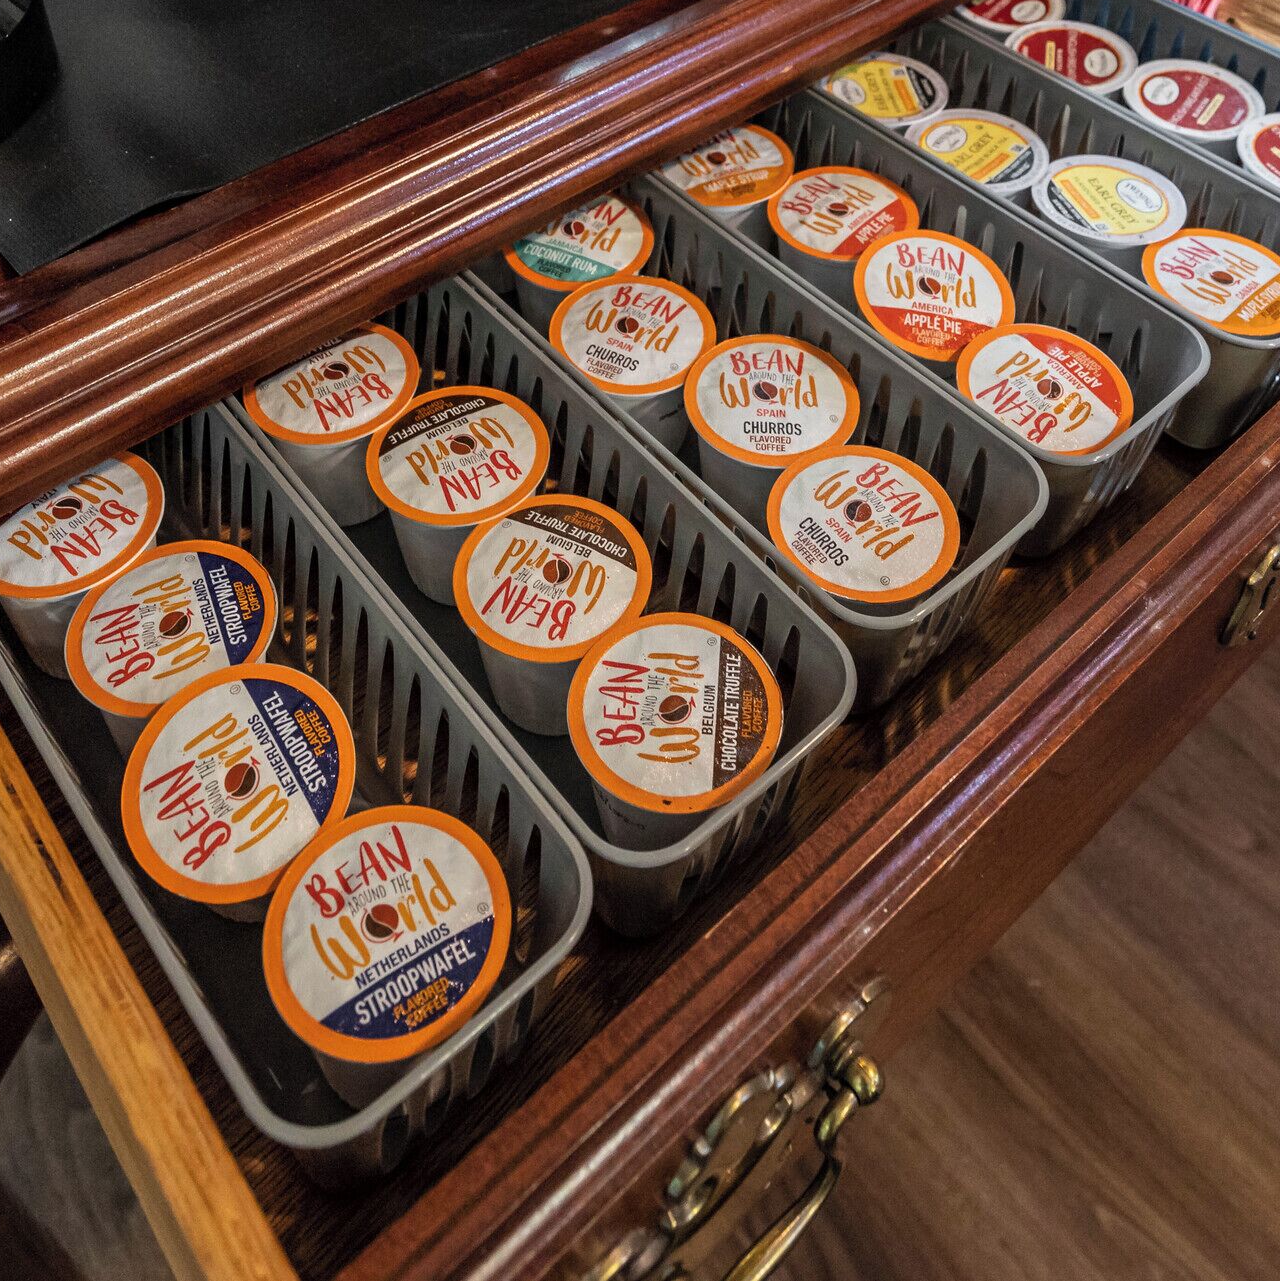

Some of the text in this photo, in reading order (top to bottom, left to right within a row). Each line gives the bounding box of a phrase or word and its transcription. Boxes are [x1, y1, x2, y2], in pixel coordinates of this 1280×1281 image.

[1085, 175, 1115, 204] EARL
[1109, 199, 1140, 228] GREY
[854, 219, 883, 244] APPLE
[875, 210, 894, 227] PIE
[523, 243, 598, 275] COCONUT RUM
[896, 243, 965, 277] BEAN
[1160, 237, 1220, 280] BEAN
[611, 285, 687, 324] BEAN
[904, 313, 962, 335] APPLE PIE
[911, 301, 954, 315] AMERICA
[1237, 294, 1268, 323] MAPLE
[308, 350, 334, 365] ITALY
[586, 344, 640, 372] CHURROS
[606, 337, 634, 352] SPAIN
[730, 349, 805, 377] BEAN
[586, 357, 623, 375] FLAVORED
[588, 366, 616, 380] COFFEE
[749, 372, 795, 385] AROUND THE
[1046, 359, 1085, 390] AMERICA
[1047, 344, 1103, 390] APPLE PIE
[312, 372, 393, 432] BEAN
[315, 387, 332, 398] THE
[975, 378, 1058, 444] BEAN
[387, 396, 485, 445] CHOCOLATE TRUFFLE
[425, 417, 469, 439] BELGIUM
[743, 421, 802, 436] CHURROS
[756, 408, 786, 418] SPAIN
[749, 435, 792, 445] FLAVORED
[755, 444, 786, 452] COFFEE
[439, 449, 523, 512] BEAN
[441, 447, 489, 475] AROUND THE
[31, 488, 58, 509] ITALY
[855, 462, 939, 527] BEAN
[859, 489, 900, 528] AROUND THE
[48, 504, 101, 544] AROUND THE
[50, 499, 140, 577] BEAN
[524, 508, 627, 558] CHOCOLATE TRUFFLE
[798, 516, 850, 567] CHURROS
[825, 516, 853, 544] SPAIN
[545, 534, 592, 559] BELGIUM
[791, 540, 818, 566] COFFEE
[793, 530, 828, 565] FLAVORED
[232, 581, 254, 620] FLAVORED
[248, 583, 261, 612] COFFEE
[514, 567, 566, 600] AROUND THE
[192, 578, 221, 645] NETHERLANDS
[209, 565, 248, 645] STROOPWAFEL
[481, 575, 576, 641] BEAN
[90, 603, 156, 688] BEAN
[138, 603, 162, 650] AROUND THE
[595, 660, 650, 746] BEAN
[642, 674, 665, 727] AROUND THE
[701, 684, 716, 736] BELGIUM
[721, 653, 742, 771] CHOCOLATE TRUFFLE
[742, 690, 754, 739] FLAVORED
[752, 698, 764, 734] COFFEE
[262, 690, 327, 794] STROOPWAFEL
[293, 709, 326, 757] FLAVORED
[306, 709, 332, 744] COFFEE
[247, 714, 299, 797] NETHERLANDS
[195, 756, 234, 819] AROUND THE
[143, 760, 232, 870] BEAN
[304, 825, 412, 919] BEAN
[346, 872, 412, 917] AROUND THE
[355, 922, 451, 990] NETHERLANDS
[355, 937, 476, 1025] STROOPWAFEL
[393, 976, 450, 1020] FLAVORED
[404, 995, 449, 1028] COFFEE
